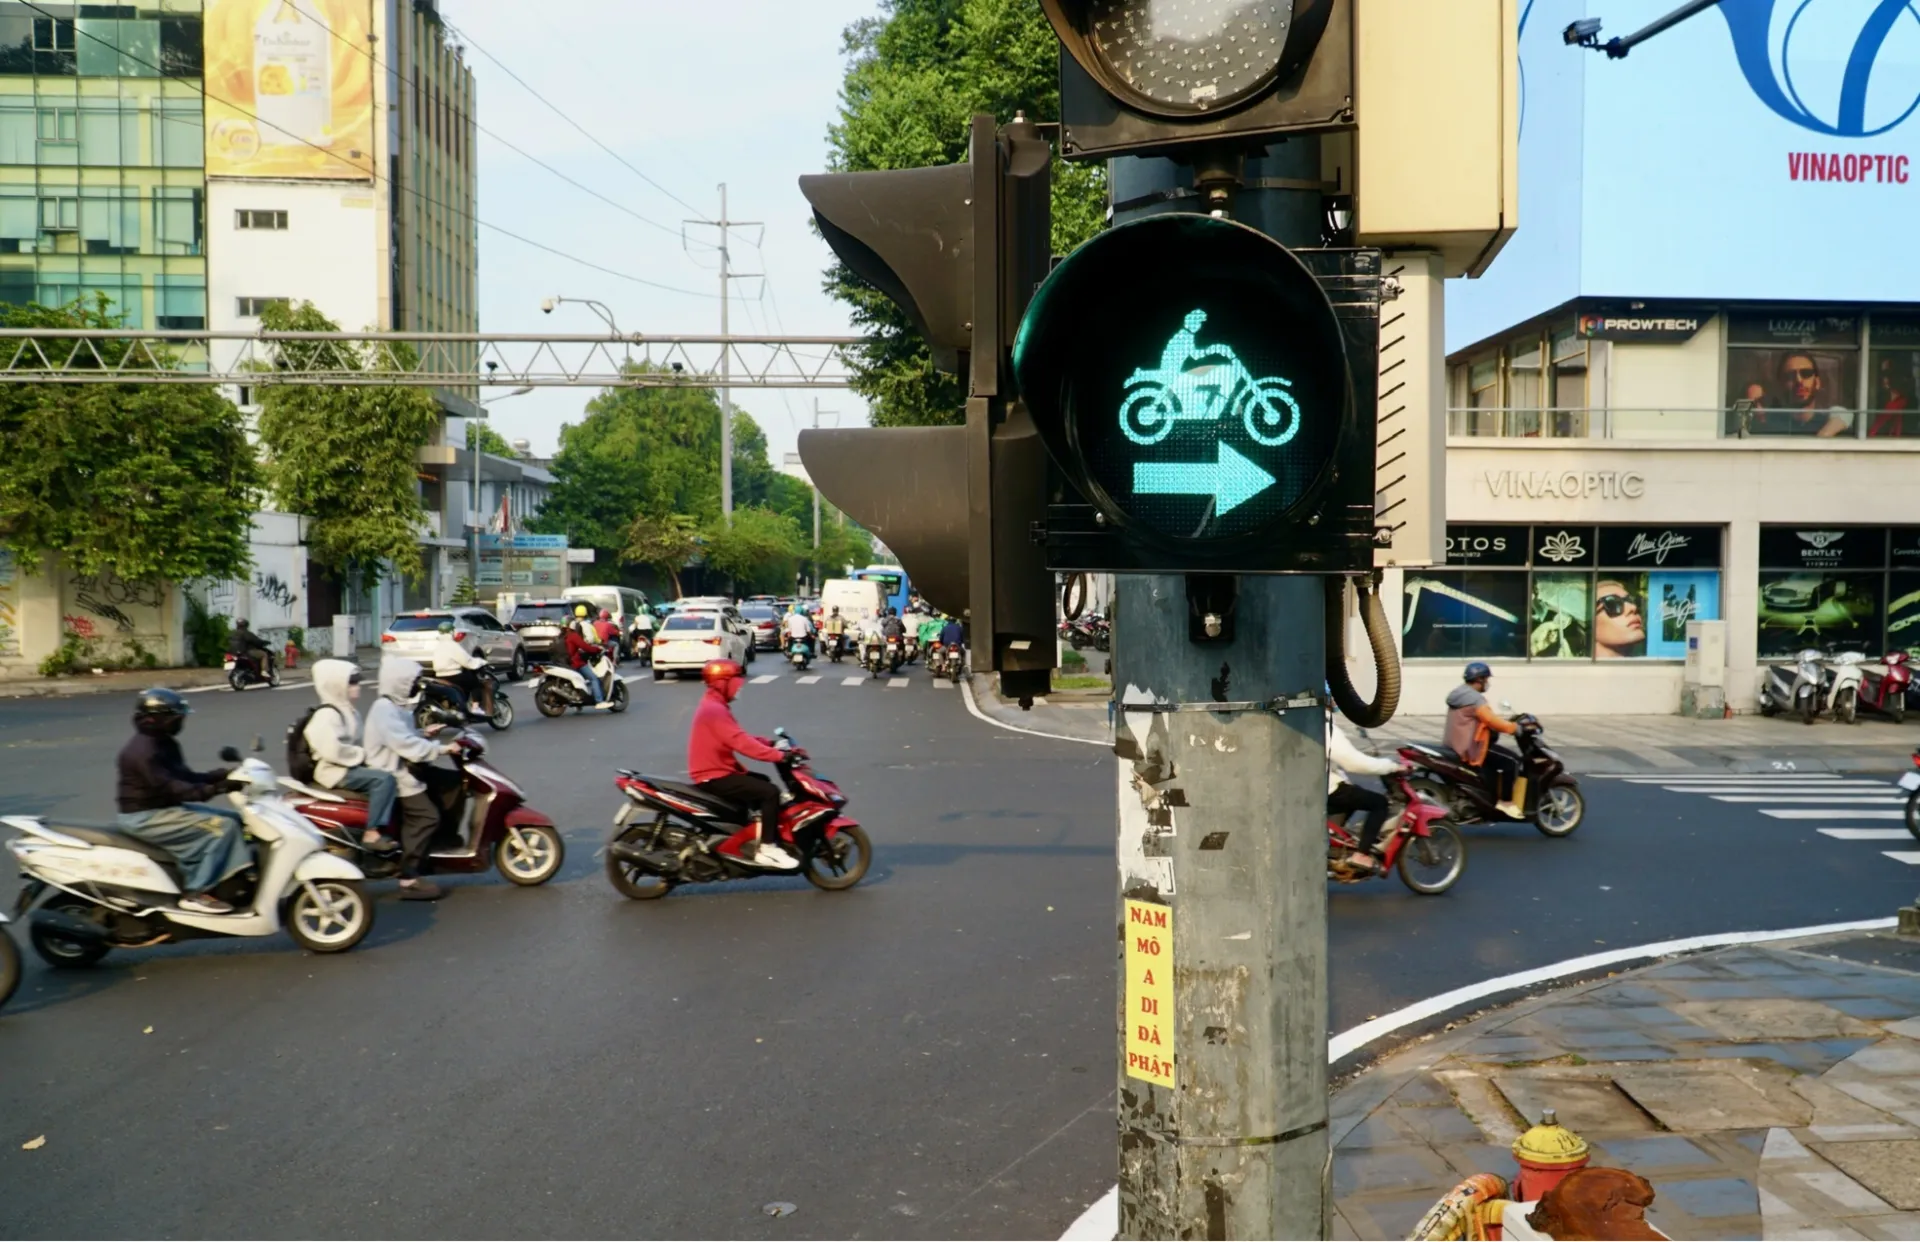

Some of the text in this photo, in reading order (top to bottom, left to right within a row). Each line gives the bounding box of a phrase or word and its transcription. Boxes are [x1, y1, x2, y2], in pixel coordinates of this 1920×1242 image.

[1788, 152, 1909, 184] VINAOPTIC
[1604, 318, 1697, 331] PROWTECH
[1484, 471, 1644, 499] VINAOPTIC
[1627, 530, 1692, 565] Maui Jim
[1801, 549, 1843, 557] BENTLEY
[1130, 906, 1167, 928] NAM
[1137, 936, 1161, 956] MÔ
[1143, 969, 1155, 985] A
[1141, 996, 1158, 1015] DI
[1138, 1025, 1161, 1045] ĐÀ
[1128, 1051, 1172, 1078] PHẬT
